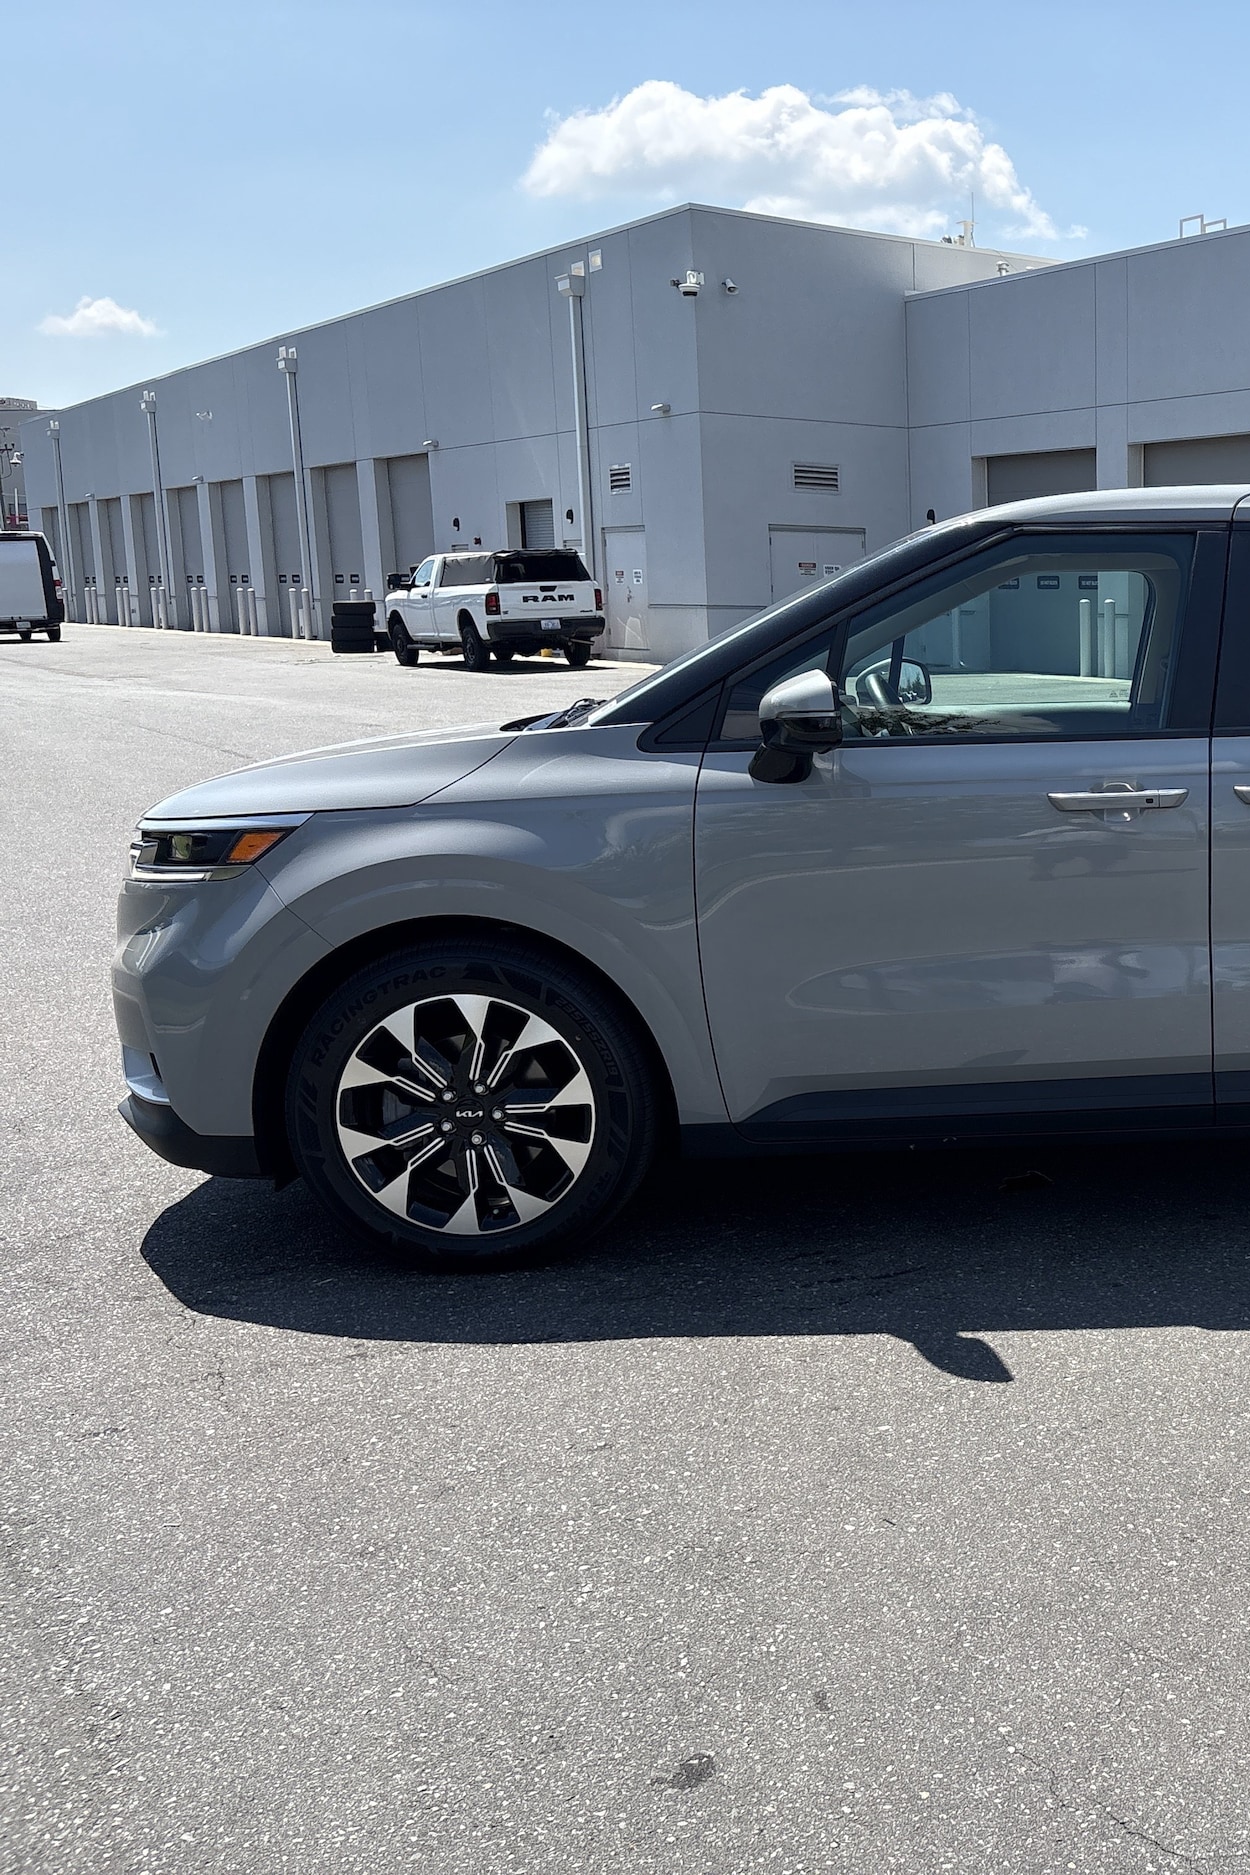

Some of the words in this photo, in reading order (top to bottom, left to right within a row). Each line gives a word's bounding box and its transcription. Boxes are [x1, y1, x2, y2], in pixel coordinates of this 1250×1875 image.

[522, 594, 575, 603] RAM
[311, 965, 447, 1068] RACINGTRAC
[455, 1110, 484, 1118] KIA
